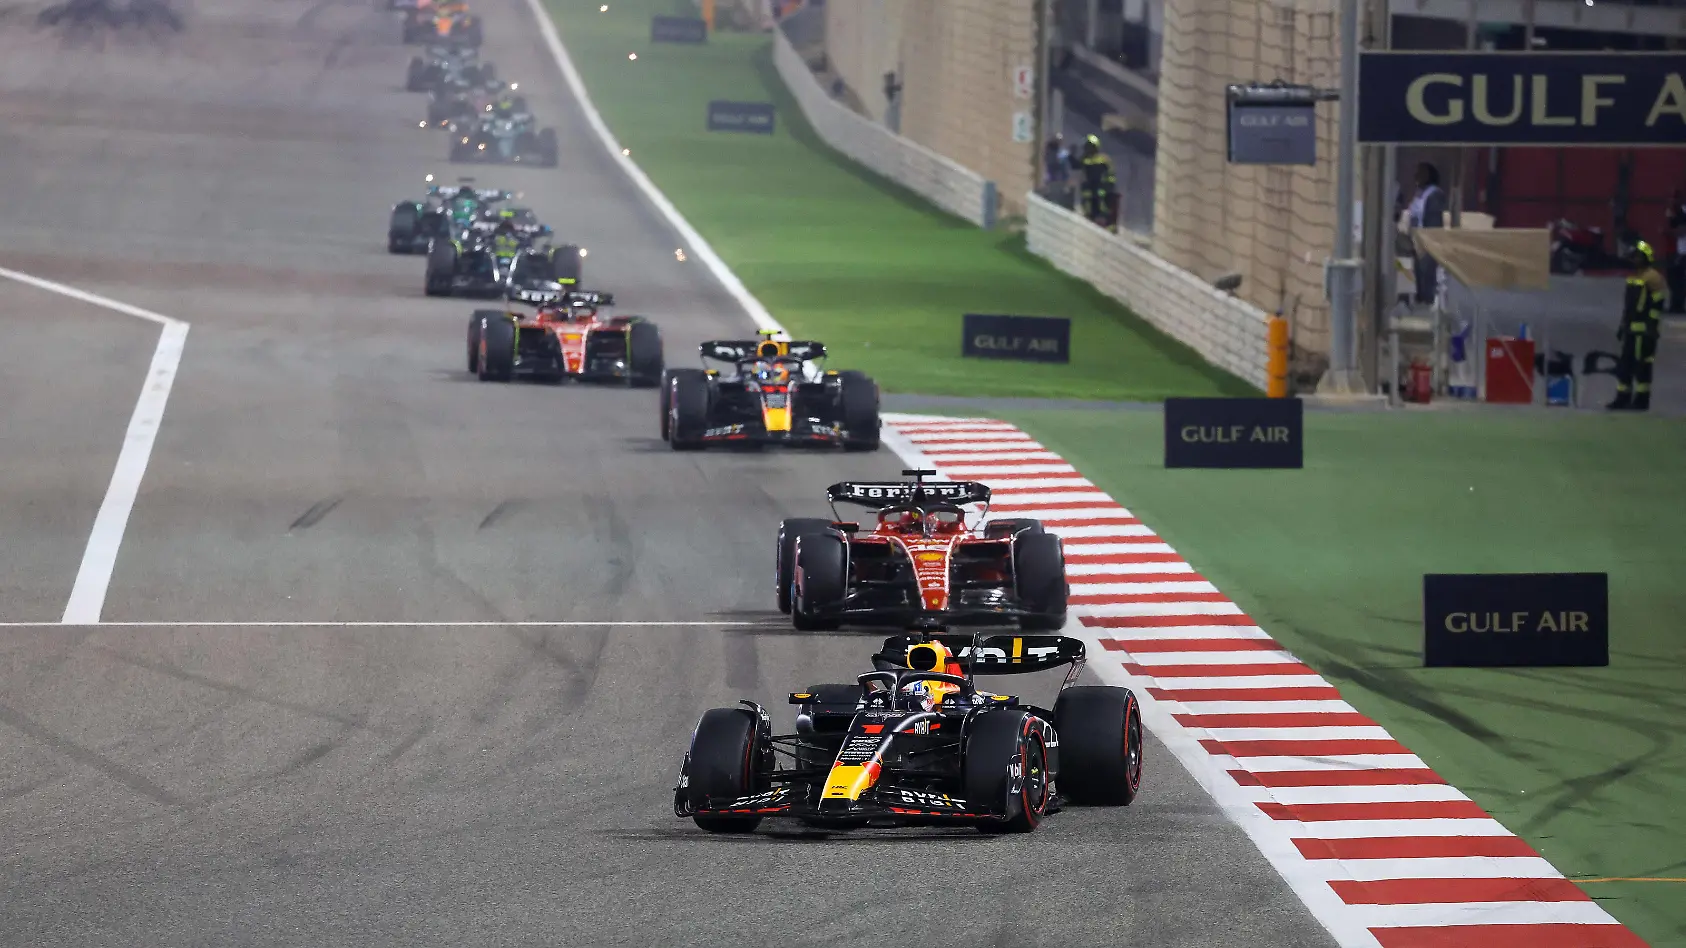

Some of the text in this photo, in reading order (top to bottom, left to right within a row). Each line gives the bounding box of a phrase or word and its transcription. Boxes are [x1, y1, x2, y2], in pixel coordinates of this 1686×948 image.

[1405, 72, 1626, 127] GULF
[974, 334, 1059, 354] GULF AIR
[1181, 425, 1290, 443] GULF AIR
[1444, 610, 1590, 633] GULF AIR
